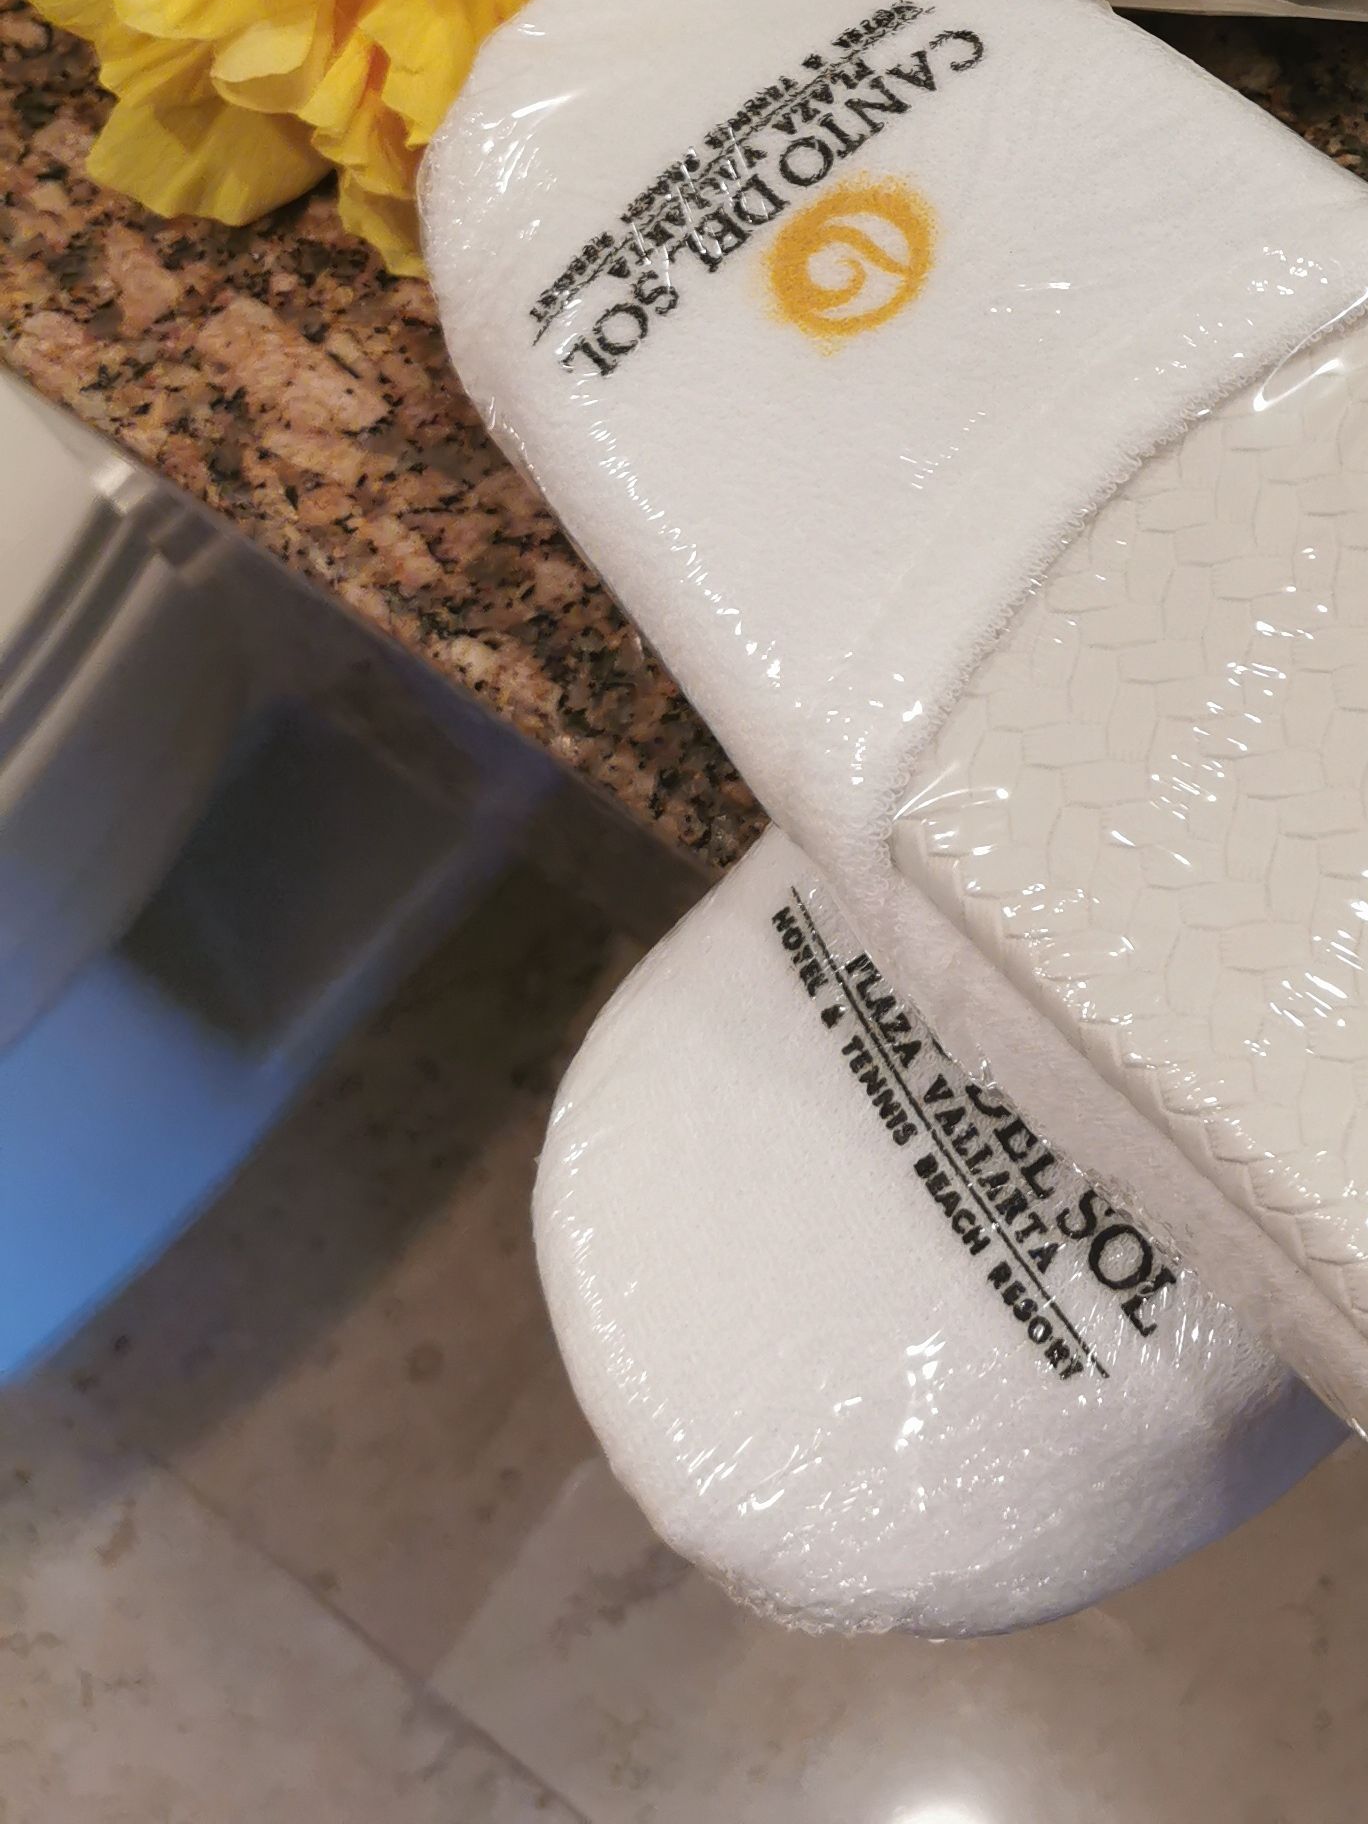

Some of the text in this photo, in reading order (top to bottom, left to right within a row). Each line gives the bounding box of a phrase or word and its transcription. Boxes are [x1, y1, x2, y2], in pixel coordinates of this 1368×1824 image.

[560, 29, 985, 378] CANTO DEL SOL
[607, 56, 876, 280] PLAZA VALLARTA
[771, 905, 1086, 1382] HOTEL & TENNIS BEACH RESORT
[846, 953, 1062, 1275] PLAZA VALLARTA
[1055, 1188, 1178, 1339] SOL
